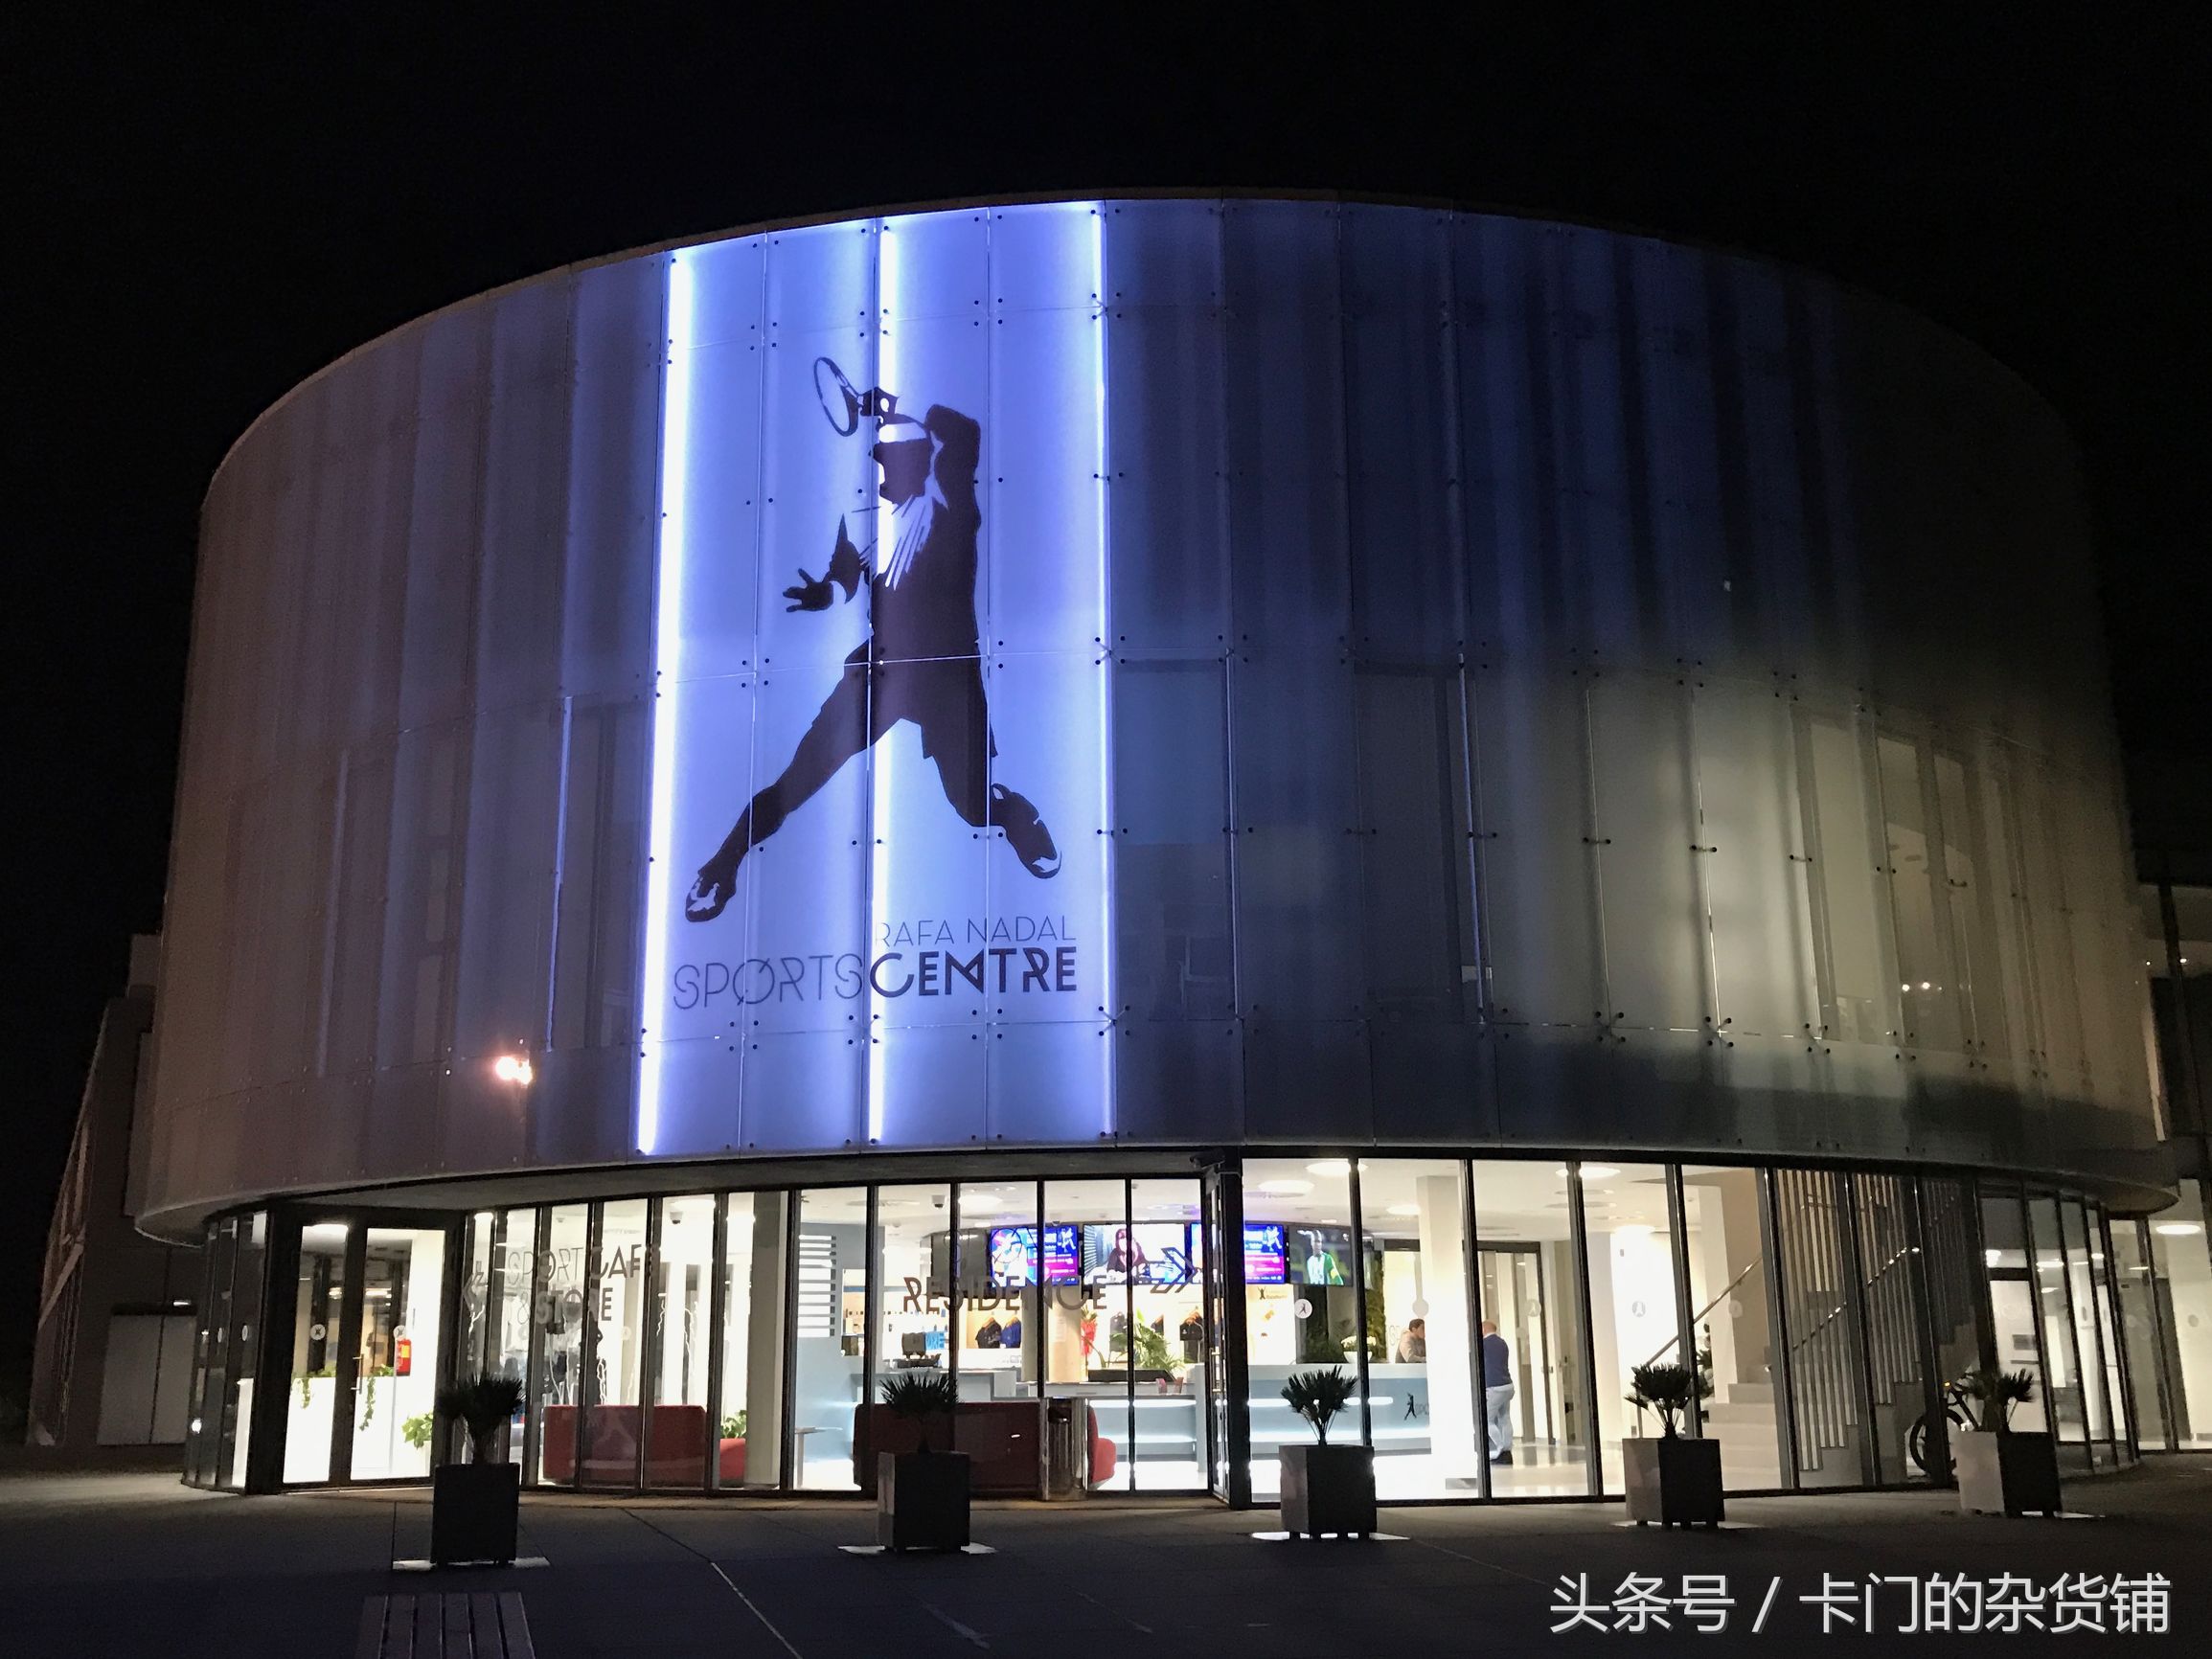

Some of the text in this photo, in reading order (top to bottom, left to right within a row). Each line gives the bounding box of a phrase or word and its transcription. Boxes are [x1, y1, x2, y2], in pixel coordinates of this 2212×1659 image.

[875, 915, 1078, 948] RAFA NADAL
[508, 1247, 583, 1285] SPORT
[903, 1275, 1107, 1313] RESIDENCE
